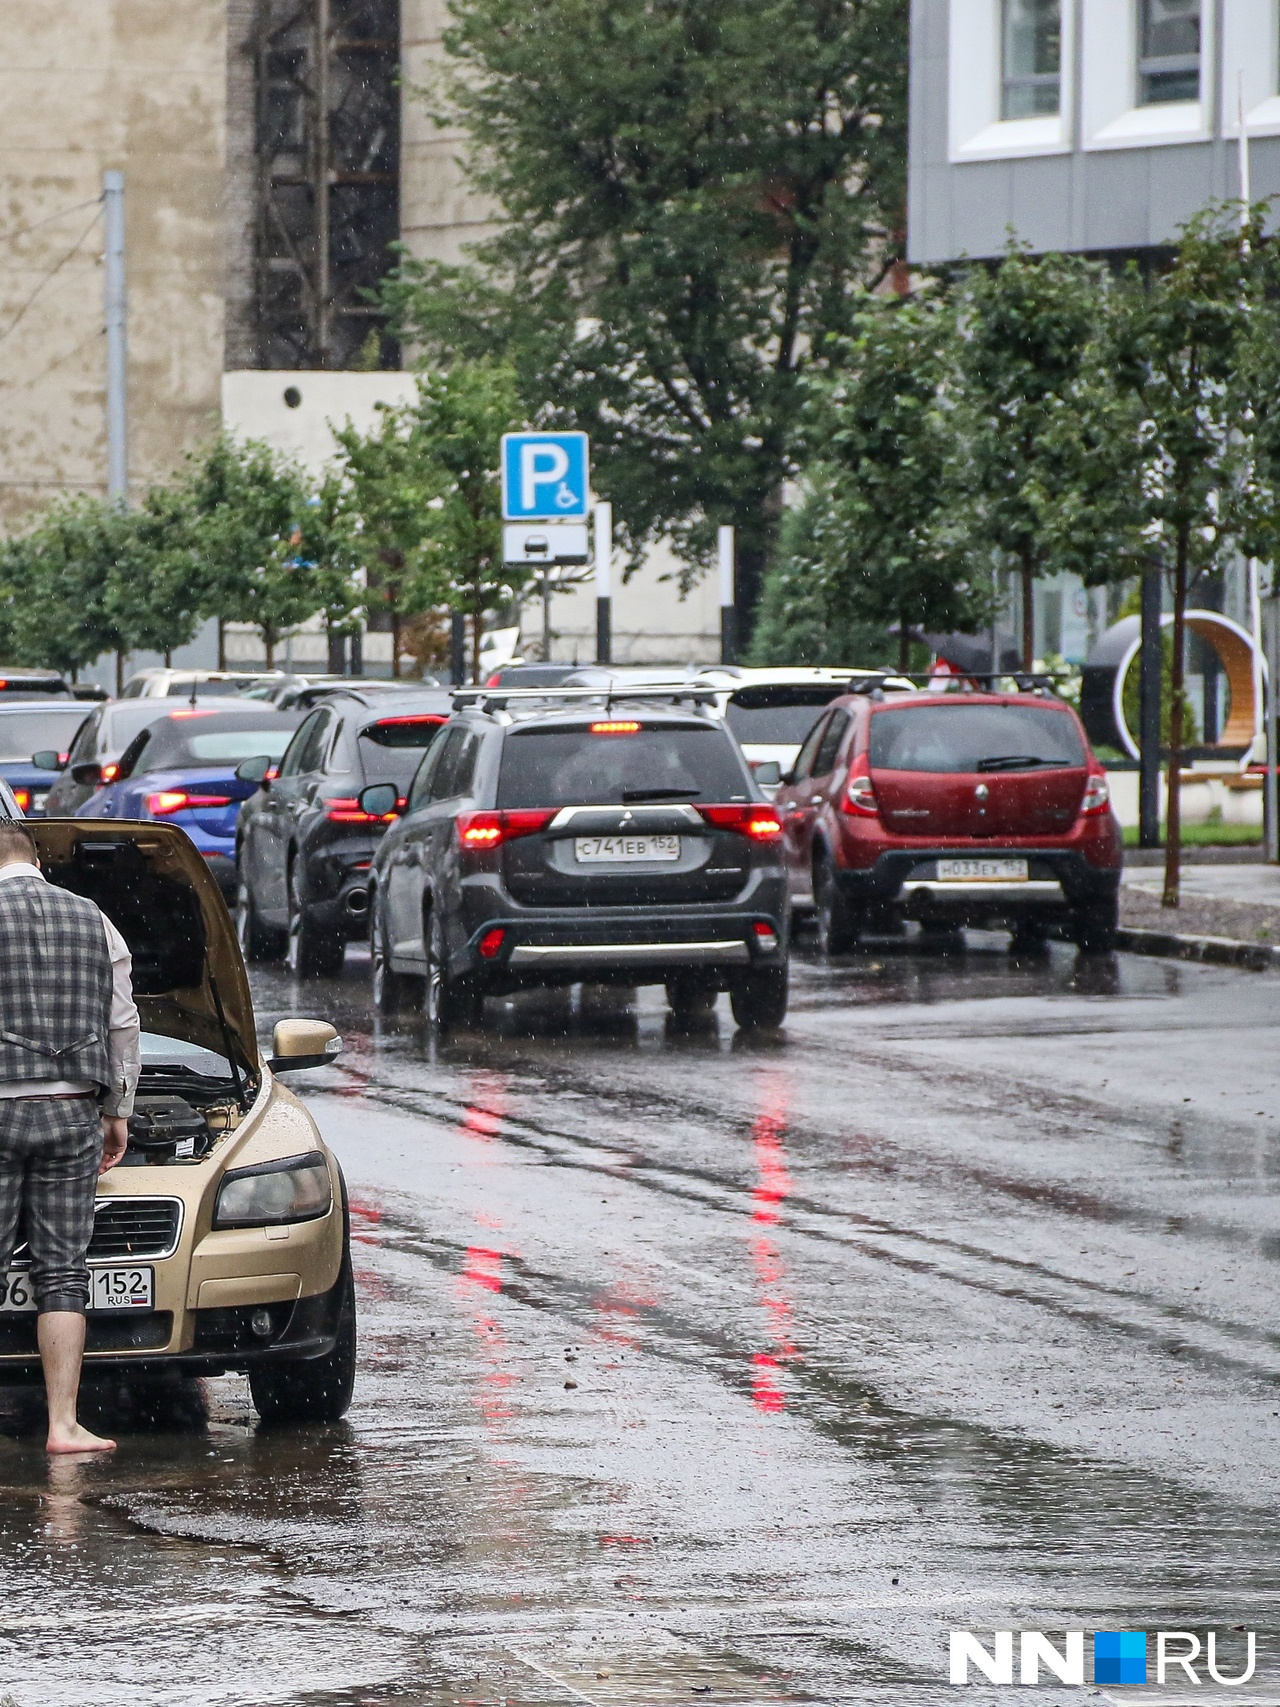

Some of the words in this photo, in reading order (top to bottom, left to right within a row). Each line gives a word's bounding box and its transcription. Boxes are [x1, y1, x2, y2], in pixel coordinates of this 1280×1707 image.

[521, 443, 569, 510] P
[651, 836, 674, 850] 152
[98, 1271, 143, 1295] 152
[108, 1296, 130, 1305] RUS
